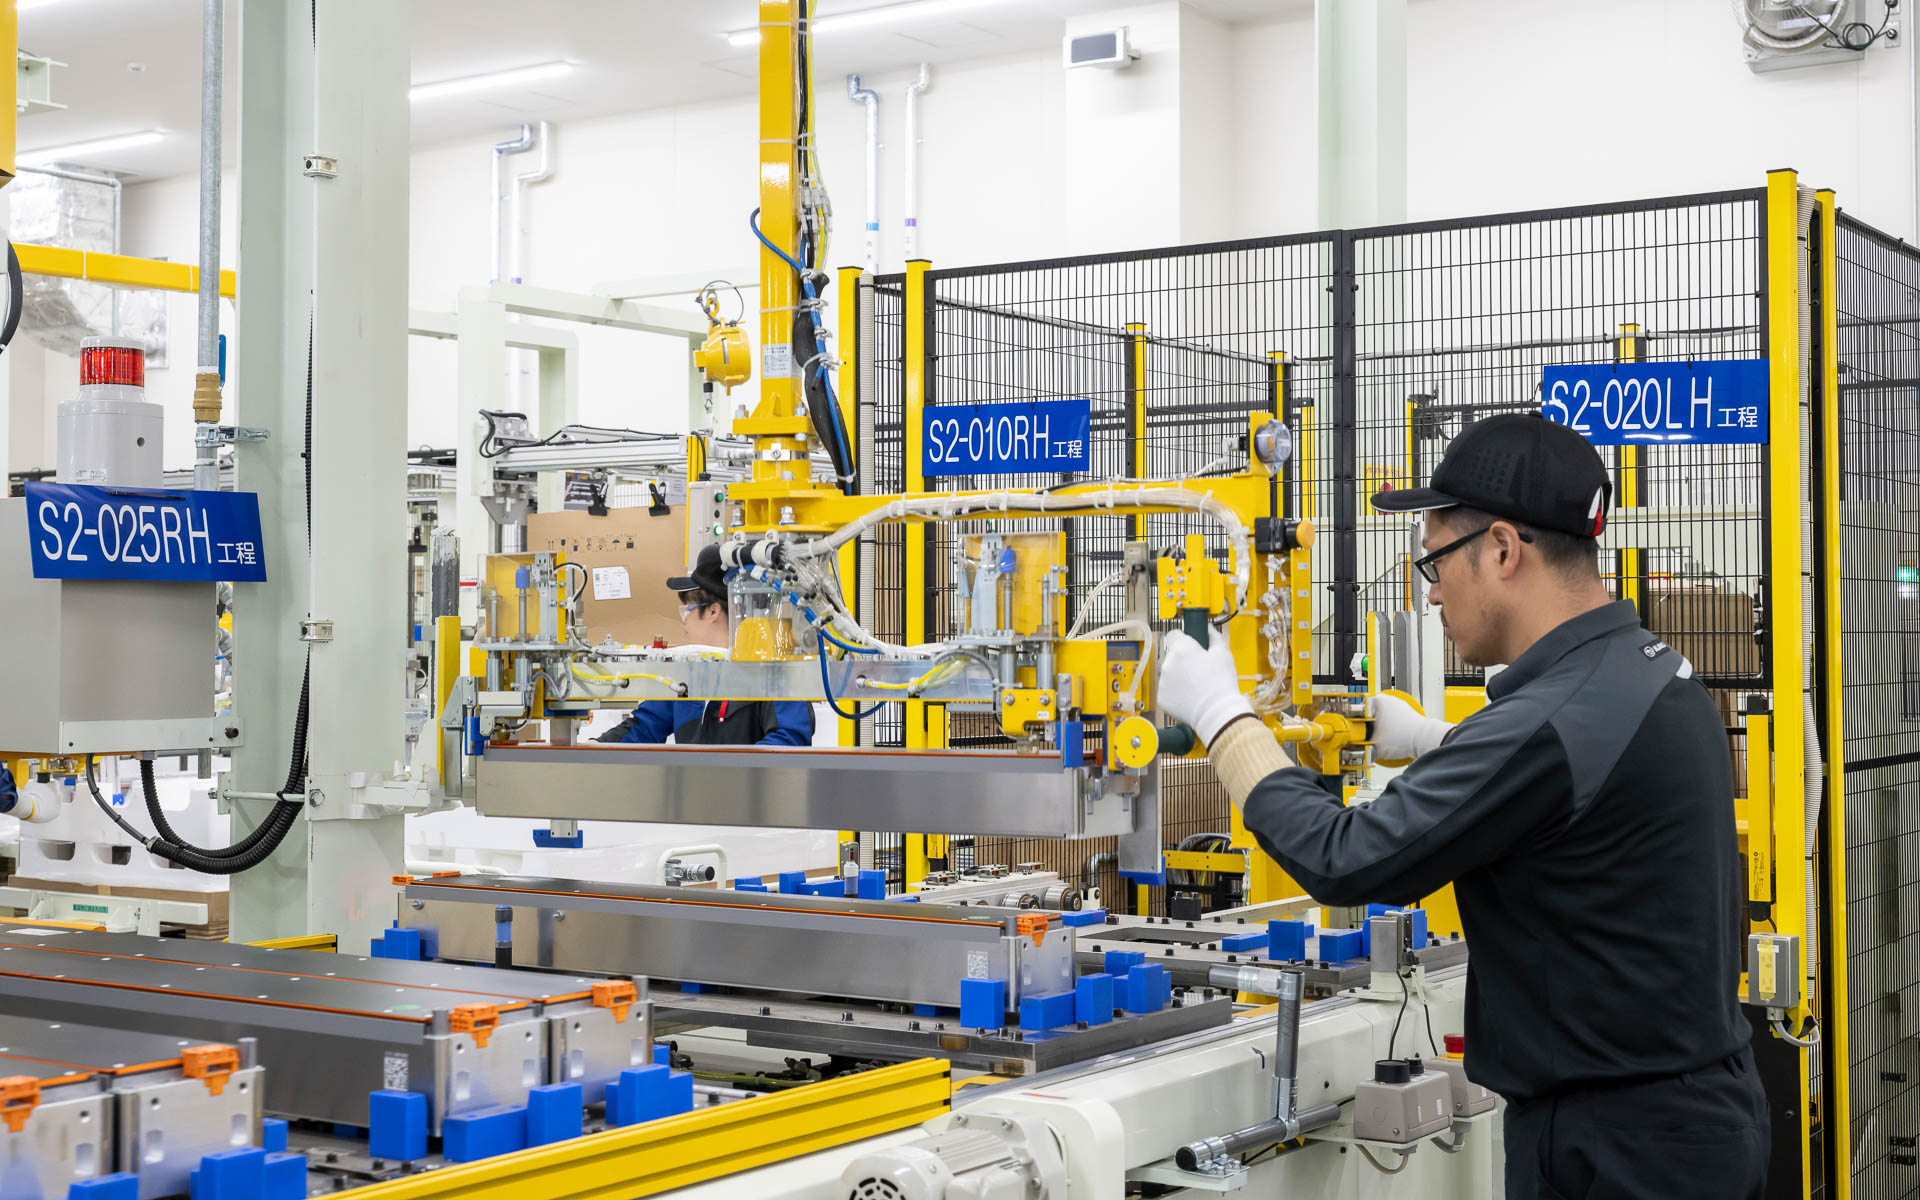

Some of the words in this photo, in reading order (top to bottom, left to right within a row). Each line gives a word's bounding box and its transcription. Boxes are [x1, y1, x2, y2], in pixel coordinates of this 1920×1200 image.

[929, 414, 1049, 463] S2-010RH
[1052, 440, 1083, 459] 工程
[1717, 406, 1758, 428] 工程
[39, 501, 212, 564] S2-025RH
[216, 542, 257, 565] 工程
